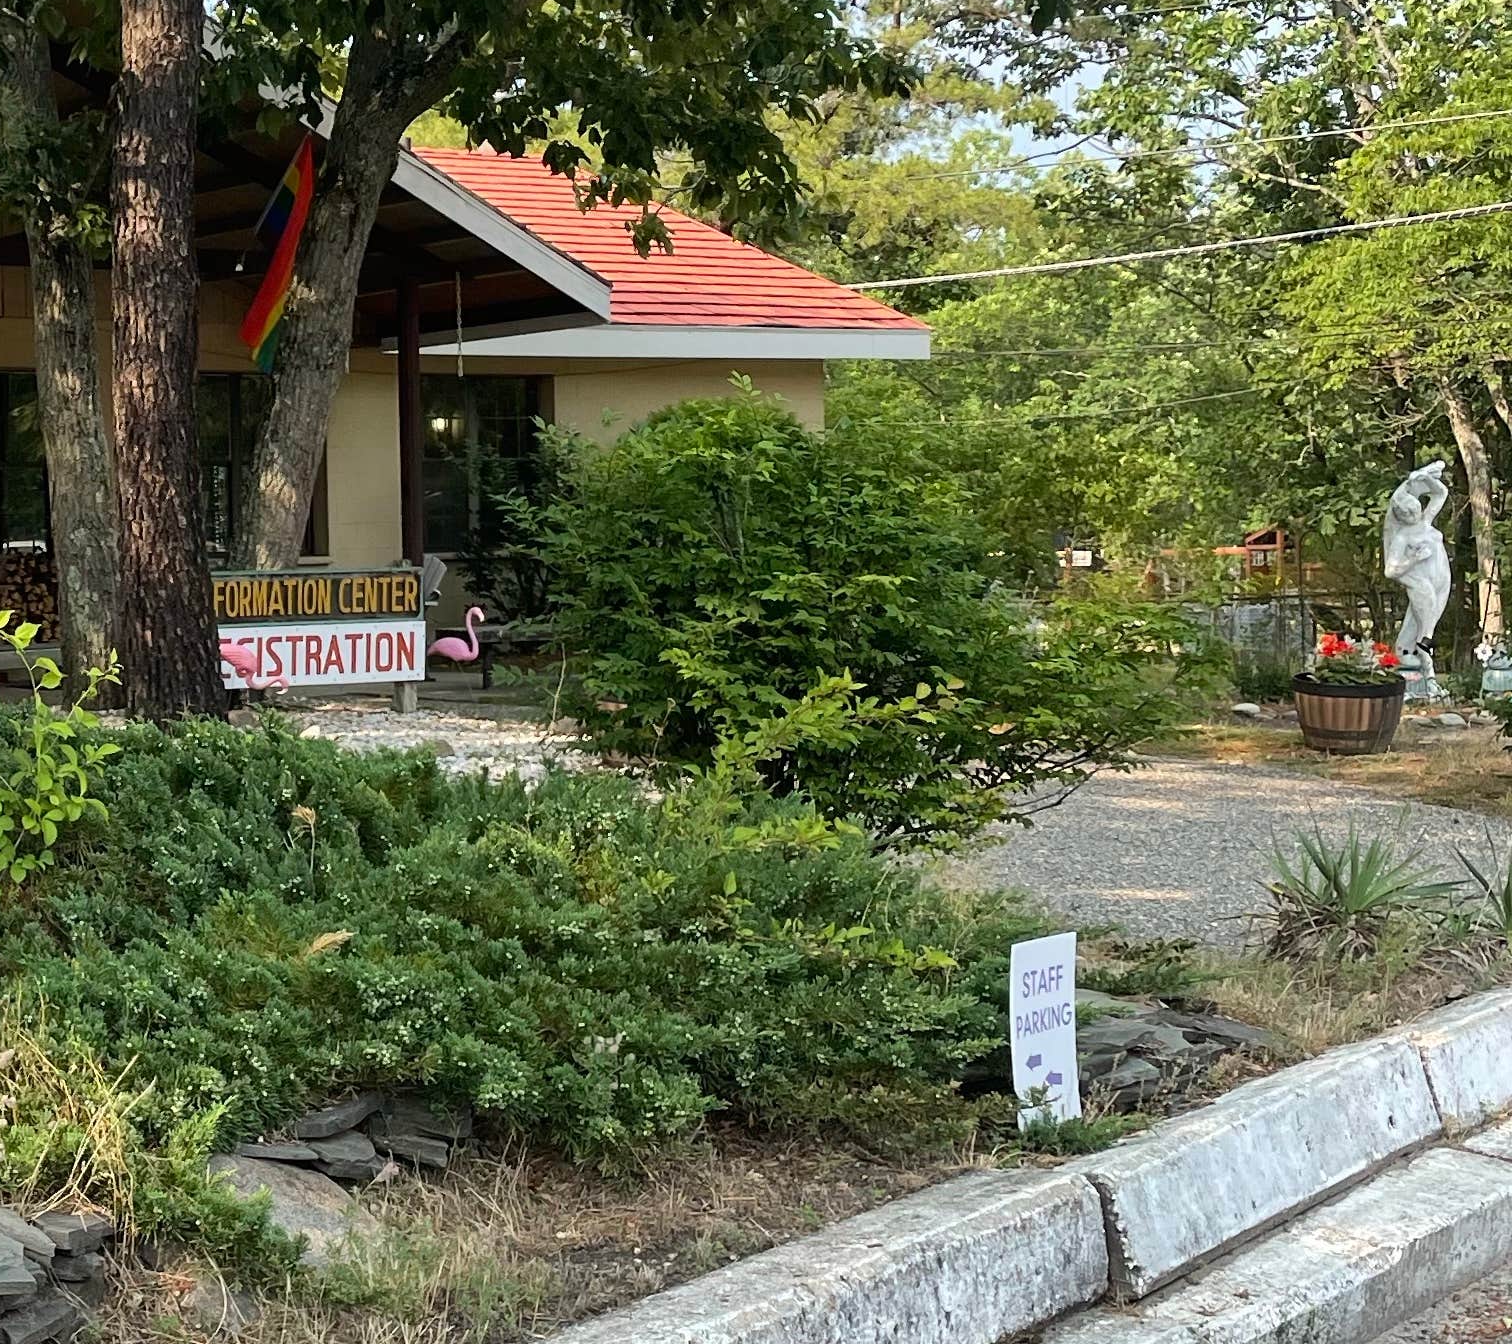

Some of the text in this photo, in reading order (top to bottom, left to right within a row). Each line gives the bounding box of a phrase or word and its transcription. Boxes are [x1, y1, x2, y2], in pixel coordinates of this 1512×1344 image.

[213, 575, 418, 618] FORMATION CENTER
[1022, 964, 1063, 998] STAFF
[1015, 1002, 1073, 1040] PARKING
